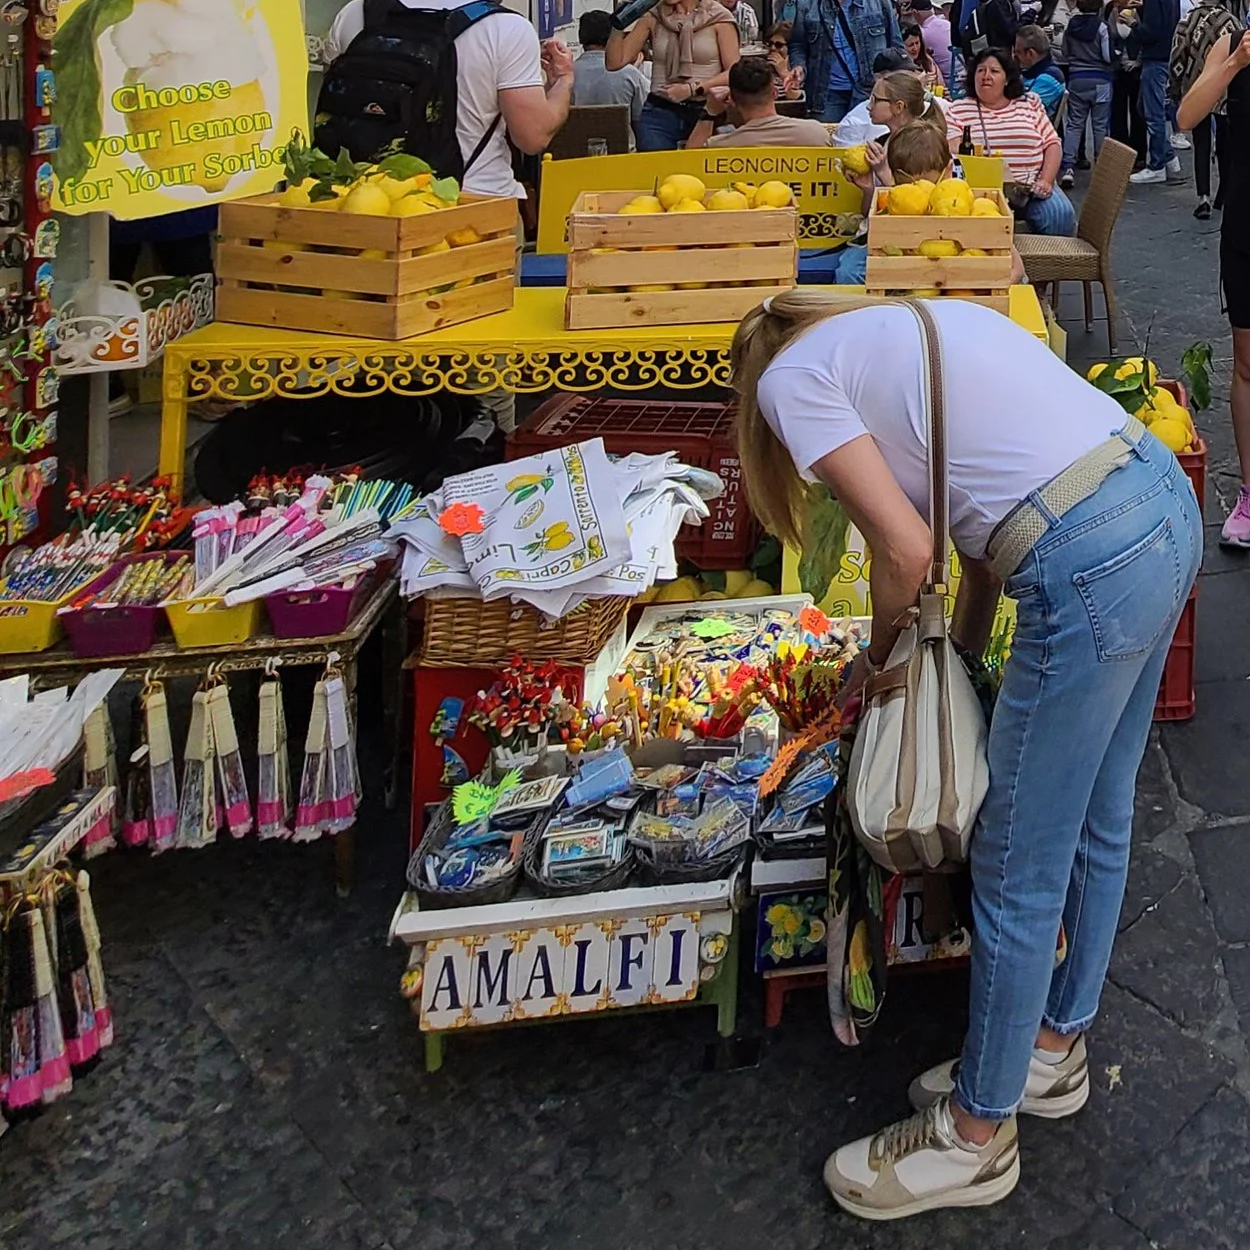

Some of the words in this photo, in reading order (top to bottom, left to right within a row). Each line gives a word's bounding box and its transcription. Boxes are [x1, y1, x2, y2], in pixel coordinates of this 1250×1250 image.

[112, 79, 231, 113] Choose
[84, 127, 161, 168] your
[170, 111, 272, 146] Lemon
[59, 177, 113, 207] for
[118, 159, 196, 196] Your
[204, 144, 288, 178] Sorbe
[705, 157, 810, 174] LEONCINO
[576, 486, 598, 531] Sorrento
[527, 560, 571, 582] Capri
[427, 930, 687, 1014] AMALFI
